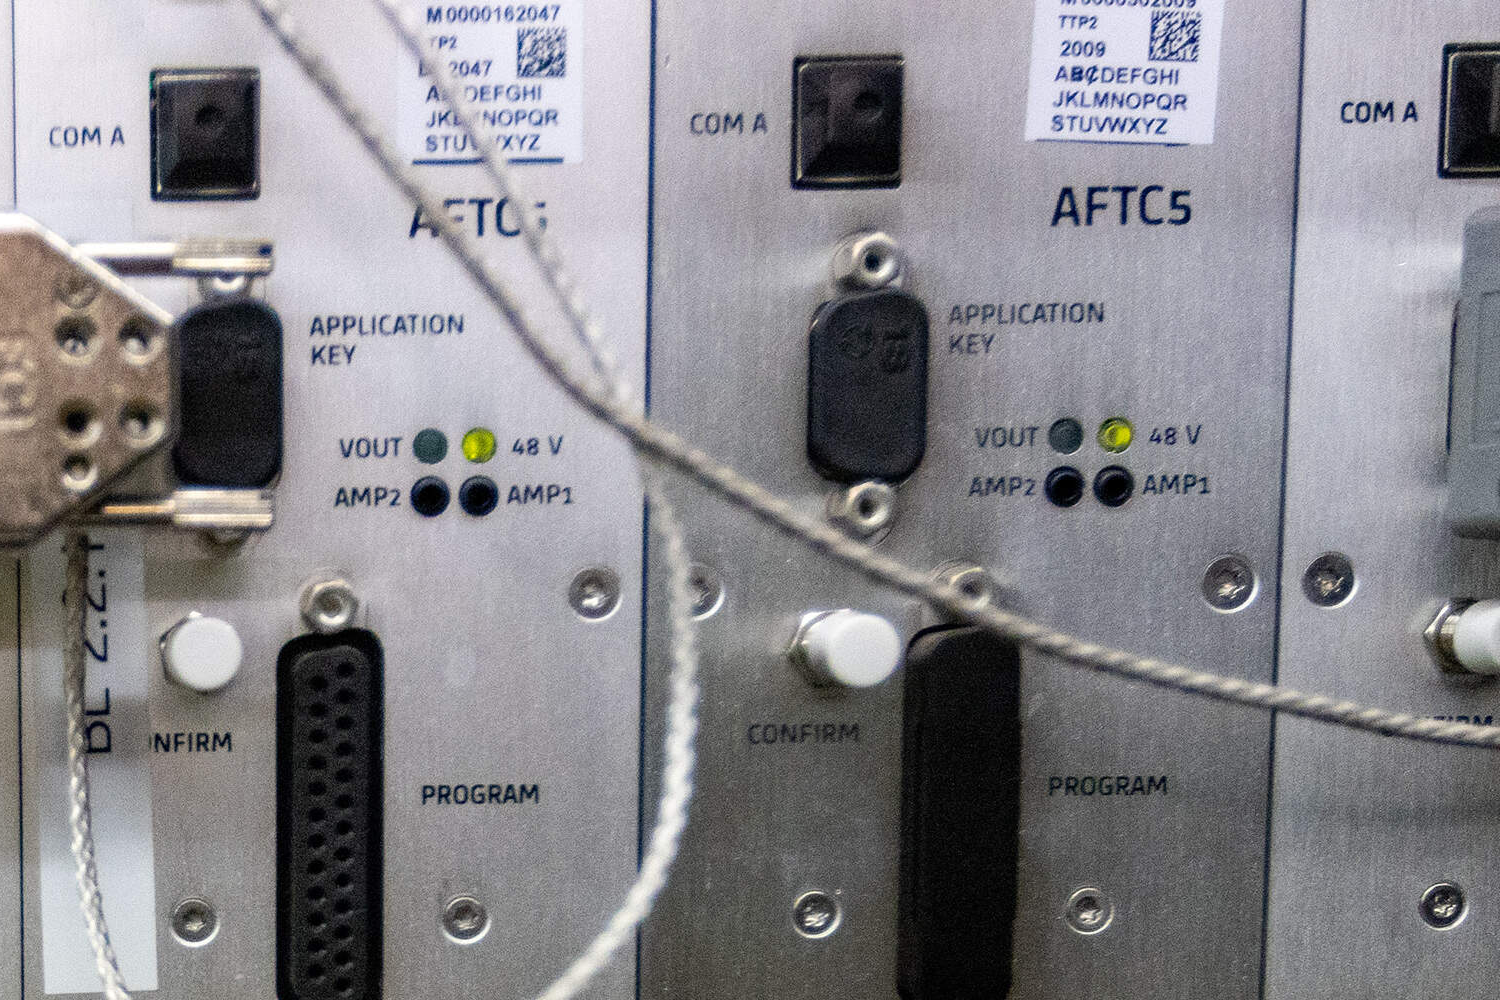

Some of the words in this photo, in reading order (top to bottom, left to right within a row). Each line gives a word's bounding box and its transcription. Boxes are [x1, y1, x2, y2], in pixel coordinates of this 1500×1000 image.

[1058, 15, 1099, 30] TTP2
[1059, 40, 1106, 58] 2009
[1052, 90, 1188, 111] JKLMNOPQR
[1340, 101, 1394, 124] COM
[1402, 101, 1418, 122] A
[689, 112, 747, 135] COM
[751, 113, 768, 133] A
[1050, 114, 1168, 135] STUVWXYZ
[49, 126, 104, 148] COM
[110, 126, 126, 146] A
[1051, 185, 1192, 226] AFTC5
[949, 302, 1105, 325] APPLICATION
[310, 315, 465, 337] APPLICATION
[950, 334, 995, 355] KEY
[311, 345, 356, 366] KEY
[511, 436, 540, 456] 48
[548, 435, 563, 456] V
[975, 427, 1039, 448] VOUT
[1149, 426, 1178, 446] 48
[1187, 425, 1202, 445] V
[339, 437, 403, 459] VOUT
[507, 485, 574, 506] AMP1
[969, 477, 1036, 497] AMP2
[1143, 474, 1211, 496] AMP1
[334, 487, 401, 507] AMP2
[747, 723, 861, 745] CONFIRM
[422, 784, 539, 805] PROGRAM
[1049, 775, 1169, 797] PROGRAM
